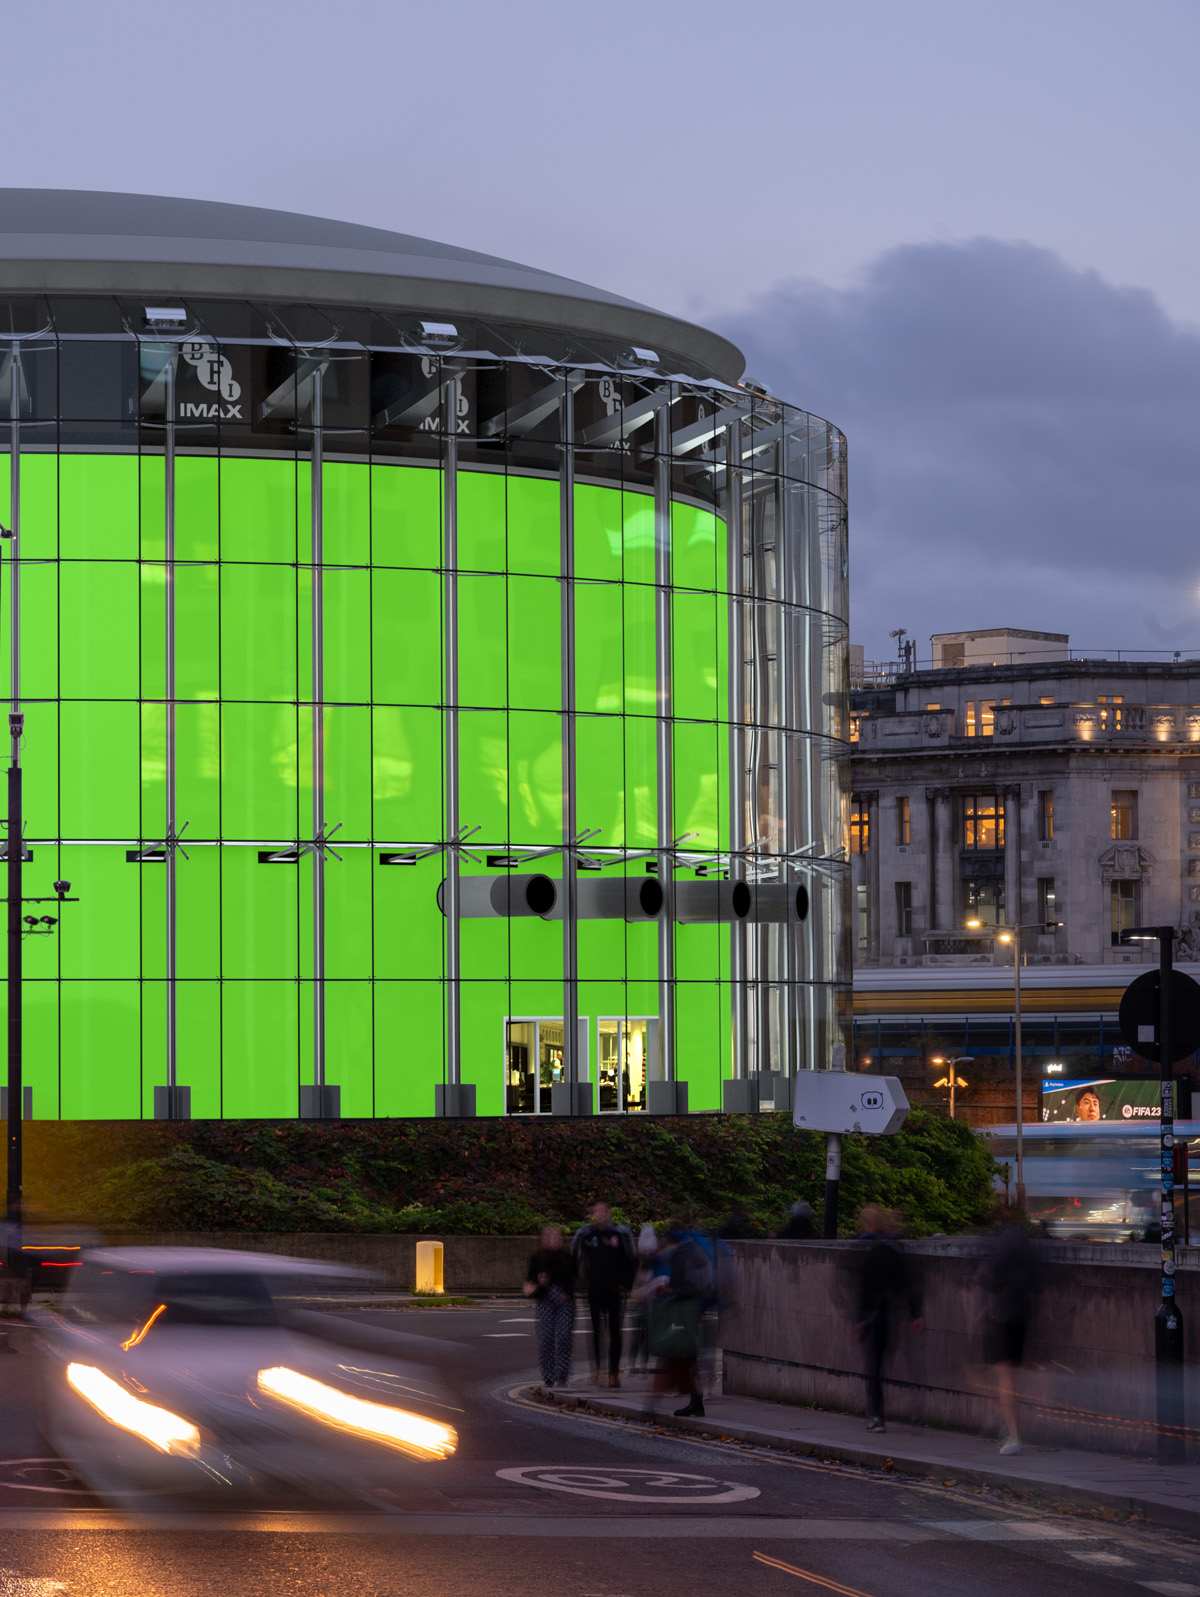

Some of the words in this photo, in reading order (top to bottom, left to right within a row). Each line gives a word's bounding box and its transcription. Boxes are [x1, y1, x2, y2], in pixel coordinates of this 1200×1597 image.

[188, 342, 235, 399] BFI
[180, 403, 243, 419] IMAX
[418, 417, 470, 434] MX
[1132, 1106, 1151, 1116] FIFA
[1151, 1106, 1162, 1116] 23
[537, 1474, 719, 1489] 20
